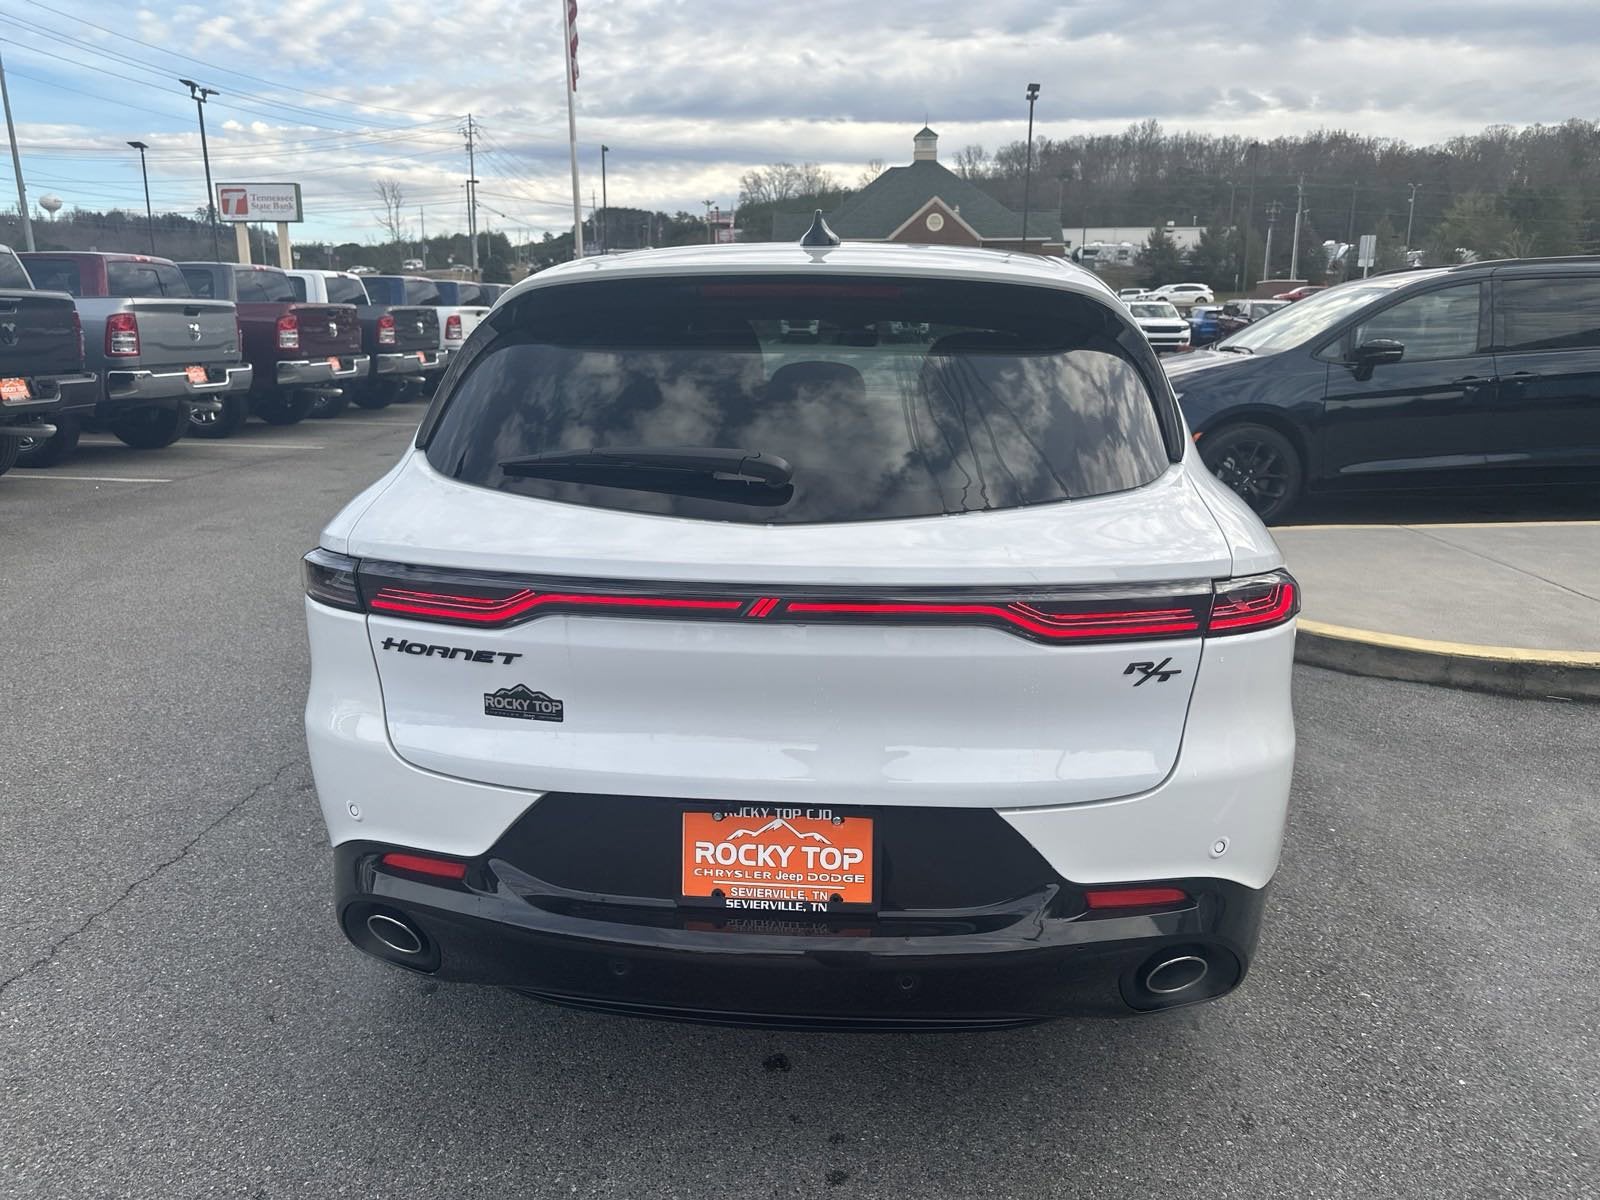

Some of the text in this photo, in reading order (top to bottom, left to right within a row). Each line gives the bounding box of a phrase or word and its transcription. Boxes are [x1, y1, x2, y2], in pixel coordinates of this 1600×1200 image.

[250, 193, 294, 202] Tennessee
[250, 202, 294, 210] State Bank
[381, 637, 523, 665] HORNET
[1123, 657, 1182, 687] R/T
[485, 696, 562, 713] ROCKY TOP
[775, 807, 801, 820] TOP
[806, 809, 832, 821] CJD
[695, 841, 864, 871] ROCKY TOP
[693, 868, 865, 883] CHRYSLER Jeep DODGE
[730, 887, 828, 902] SEVIERVILLE, TN
[725, 899, 828, 913] SEVIERVILLE, TN
